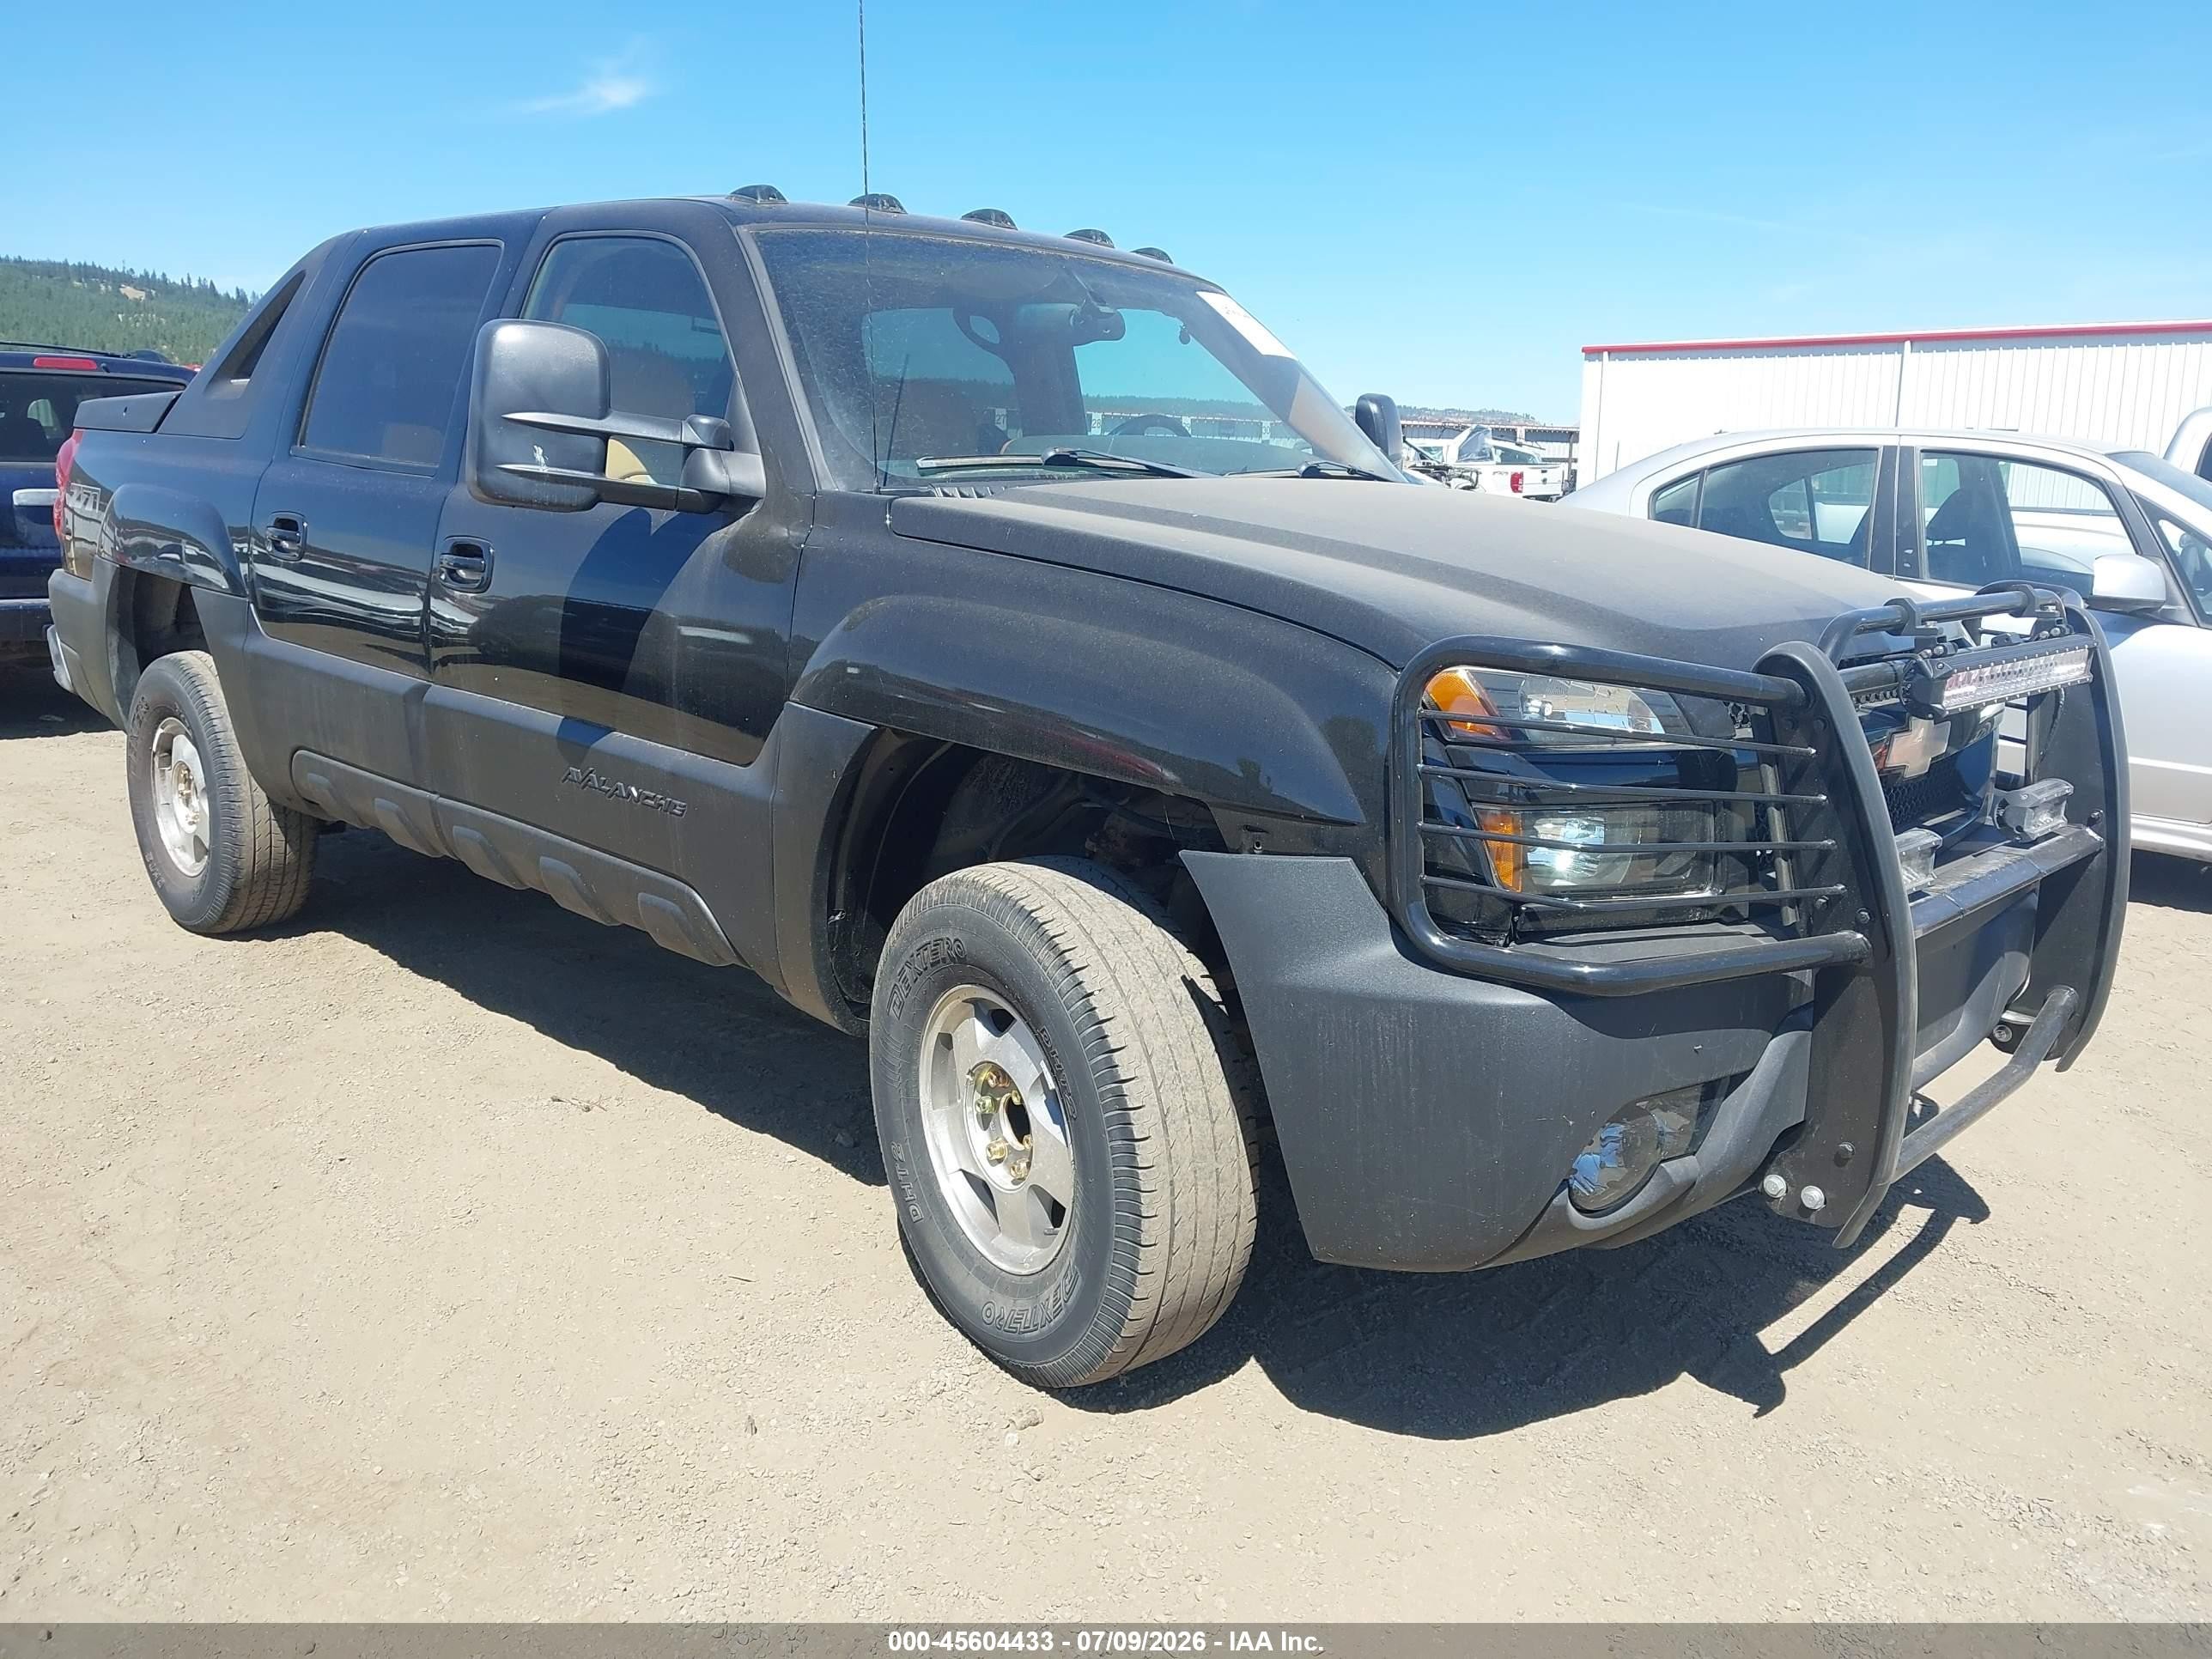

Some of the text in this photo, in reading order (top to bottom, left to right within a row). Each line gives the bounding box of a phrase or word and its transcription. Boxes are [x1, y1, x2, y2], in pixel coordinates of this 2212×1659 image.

[70, 483, 100, 513] Z71
[562, 767, 688, 817] AVALANCHE
[886, 936, 967, 1020] DEXTERO
[891, 1141, 924, 1223] DHT2
[981, 1260, 1079, 1334] DEXTERO
